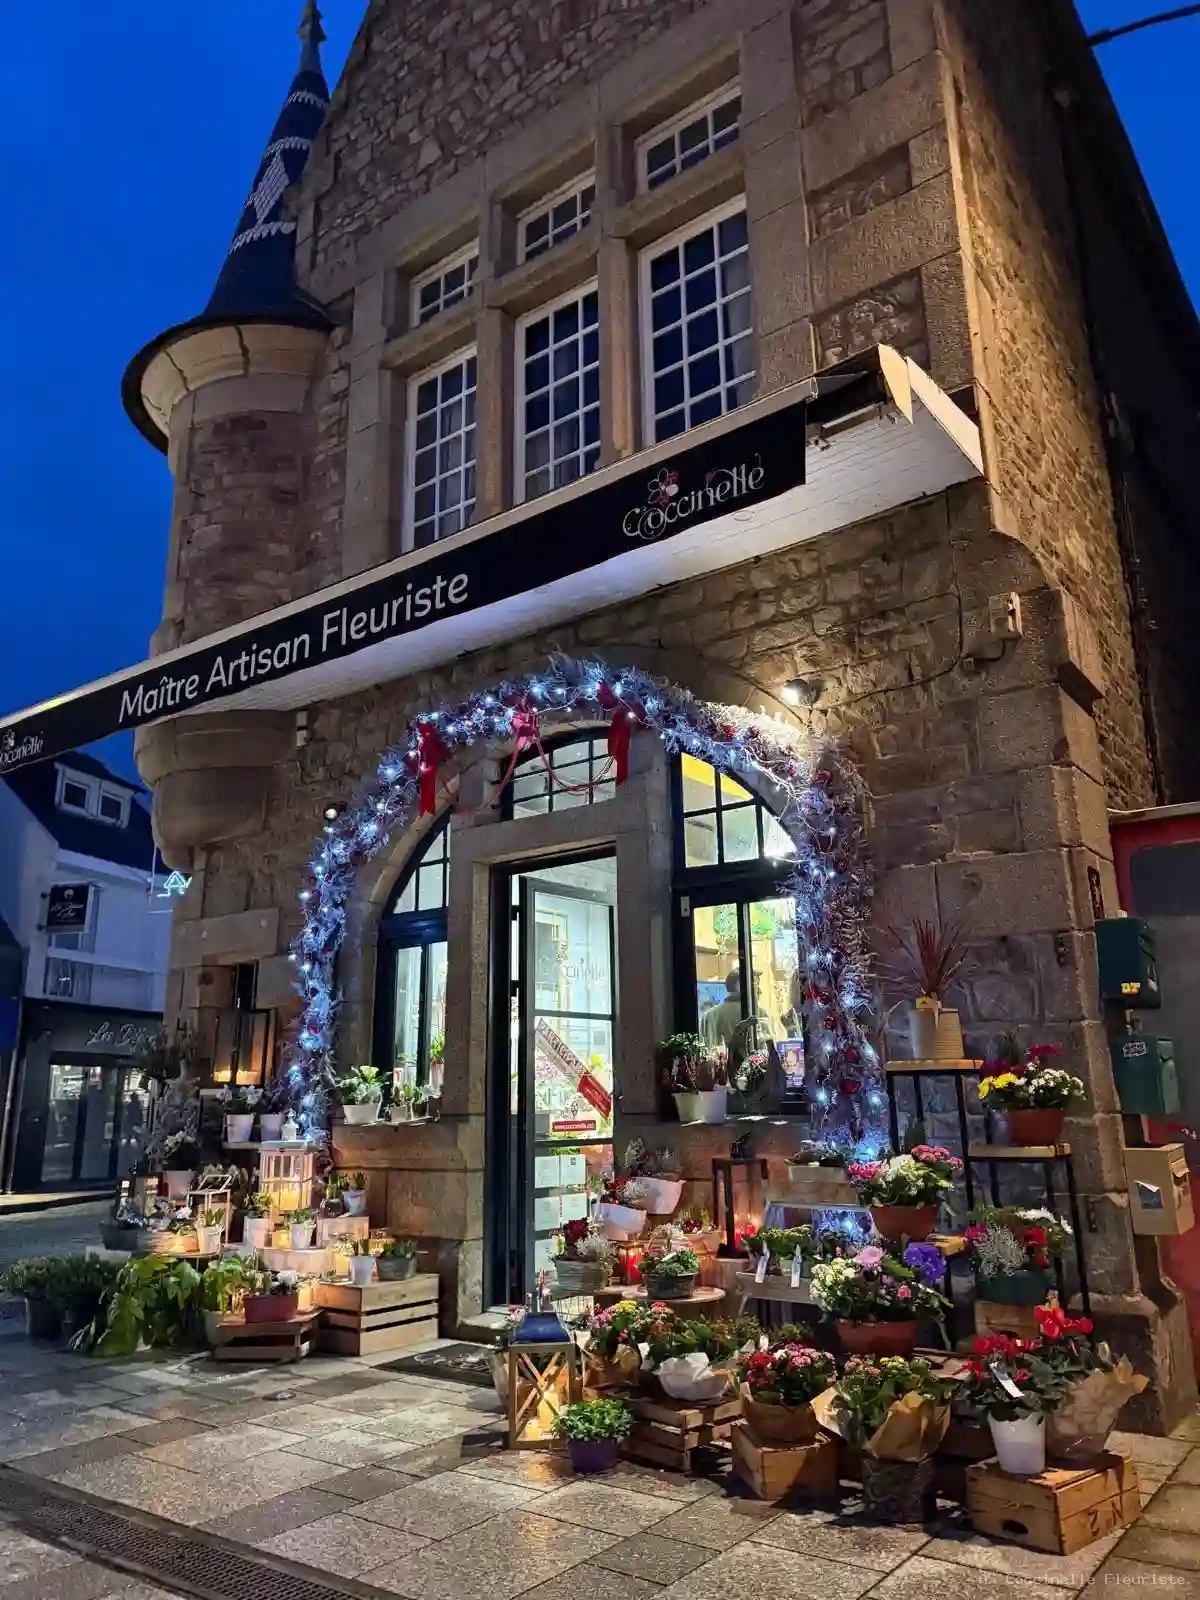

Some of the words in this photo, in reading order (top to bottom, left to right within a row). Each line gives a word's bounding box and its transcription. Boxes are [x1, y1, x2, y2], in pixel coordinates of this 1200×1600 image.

[622, 452, 765, 540] Coccinelle
[118, 674, 200, 724] Maître
[205, 632, 311, 693] Artisan
[321, 572, 469, 652] Fleuriste
[0, 730, 44, 769] occinelle
